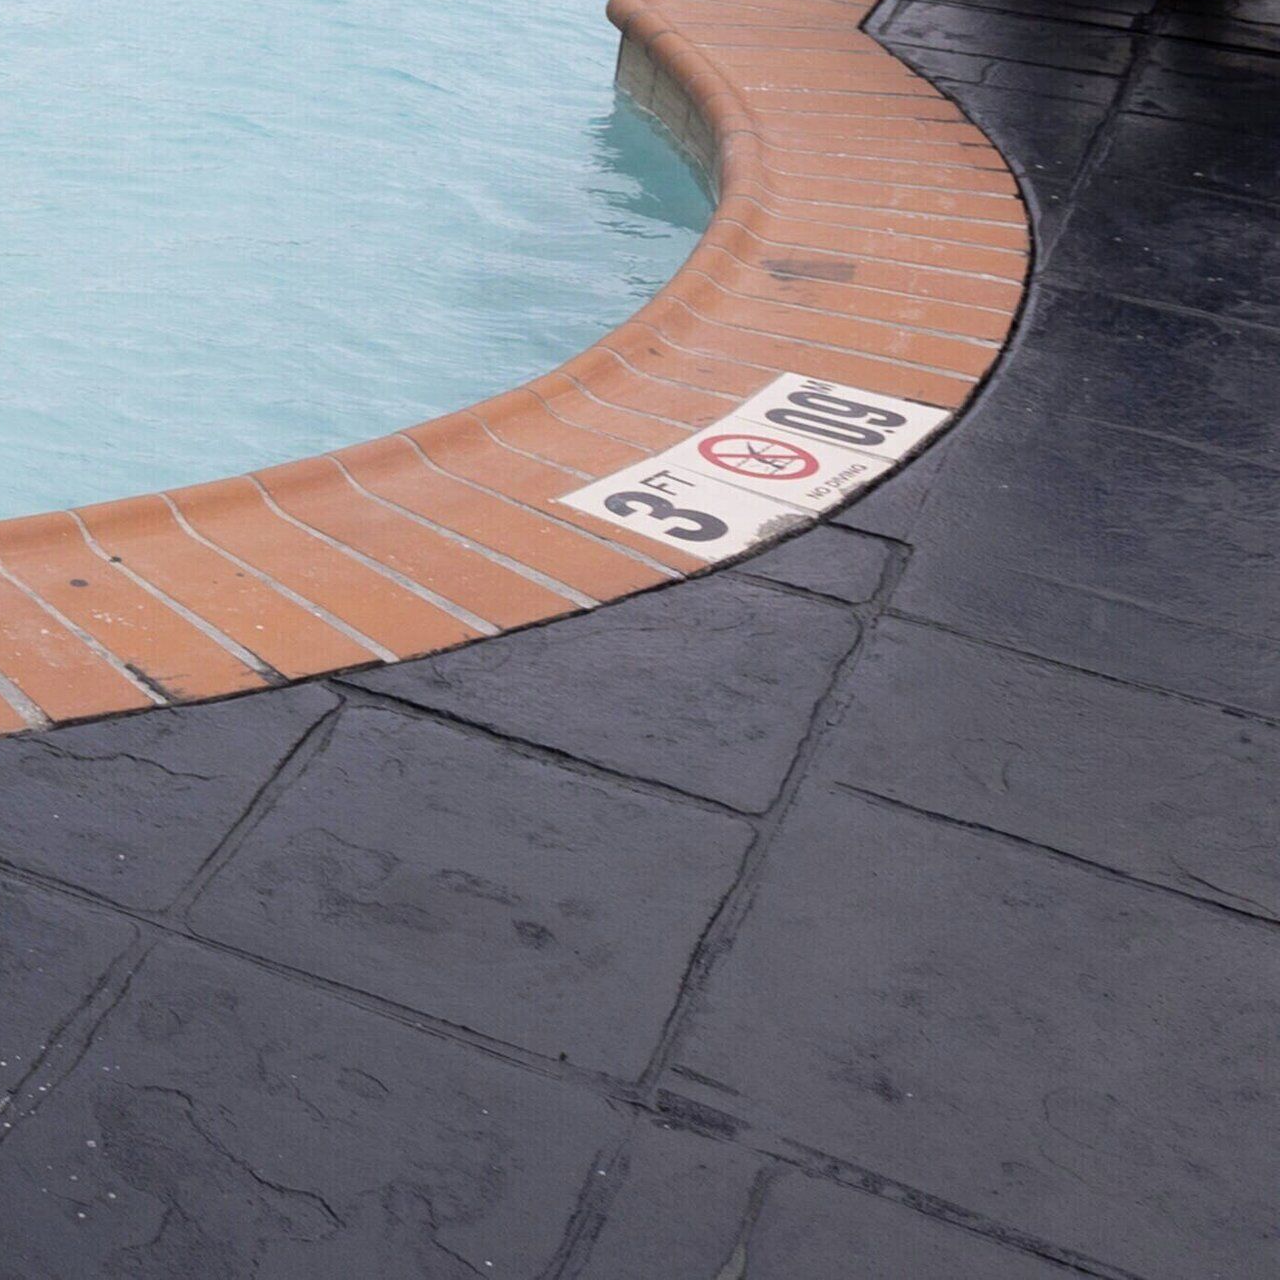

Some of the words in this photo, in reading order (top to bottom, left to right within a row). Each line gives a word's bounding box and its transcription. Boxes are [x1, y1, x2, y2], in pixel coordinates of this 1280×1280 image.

[799, 379, 837, 396] M
[639, 469, 694, 497] FT
[806, 487, 831, 500] NO
[826, 463, 867, 488] DIVING
[604, 490, 729, 543] 3
